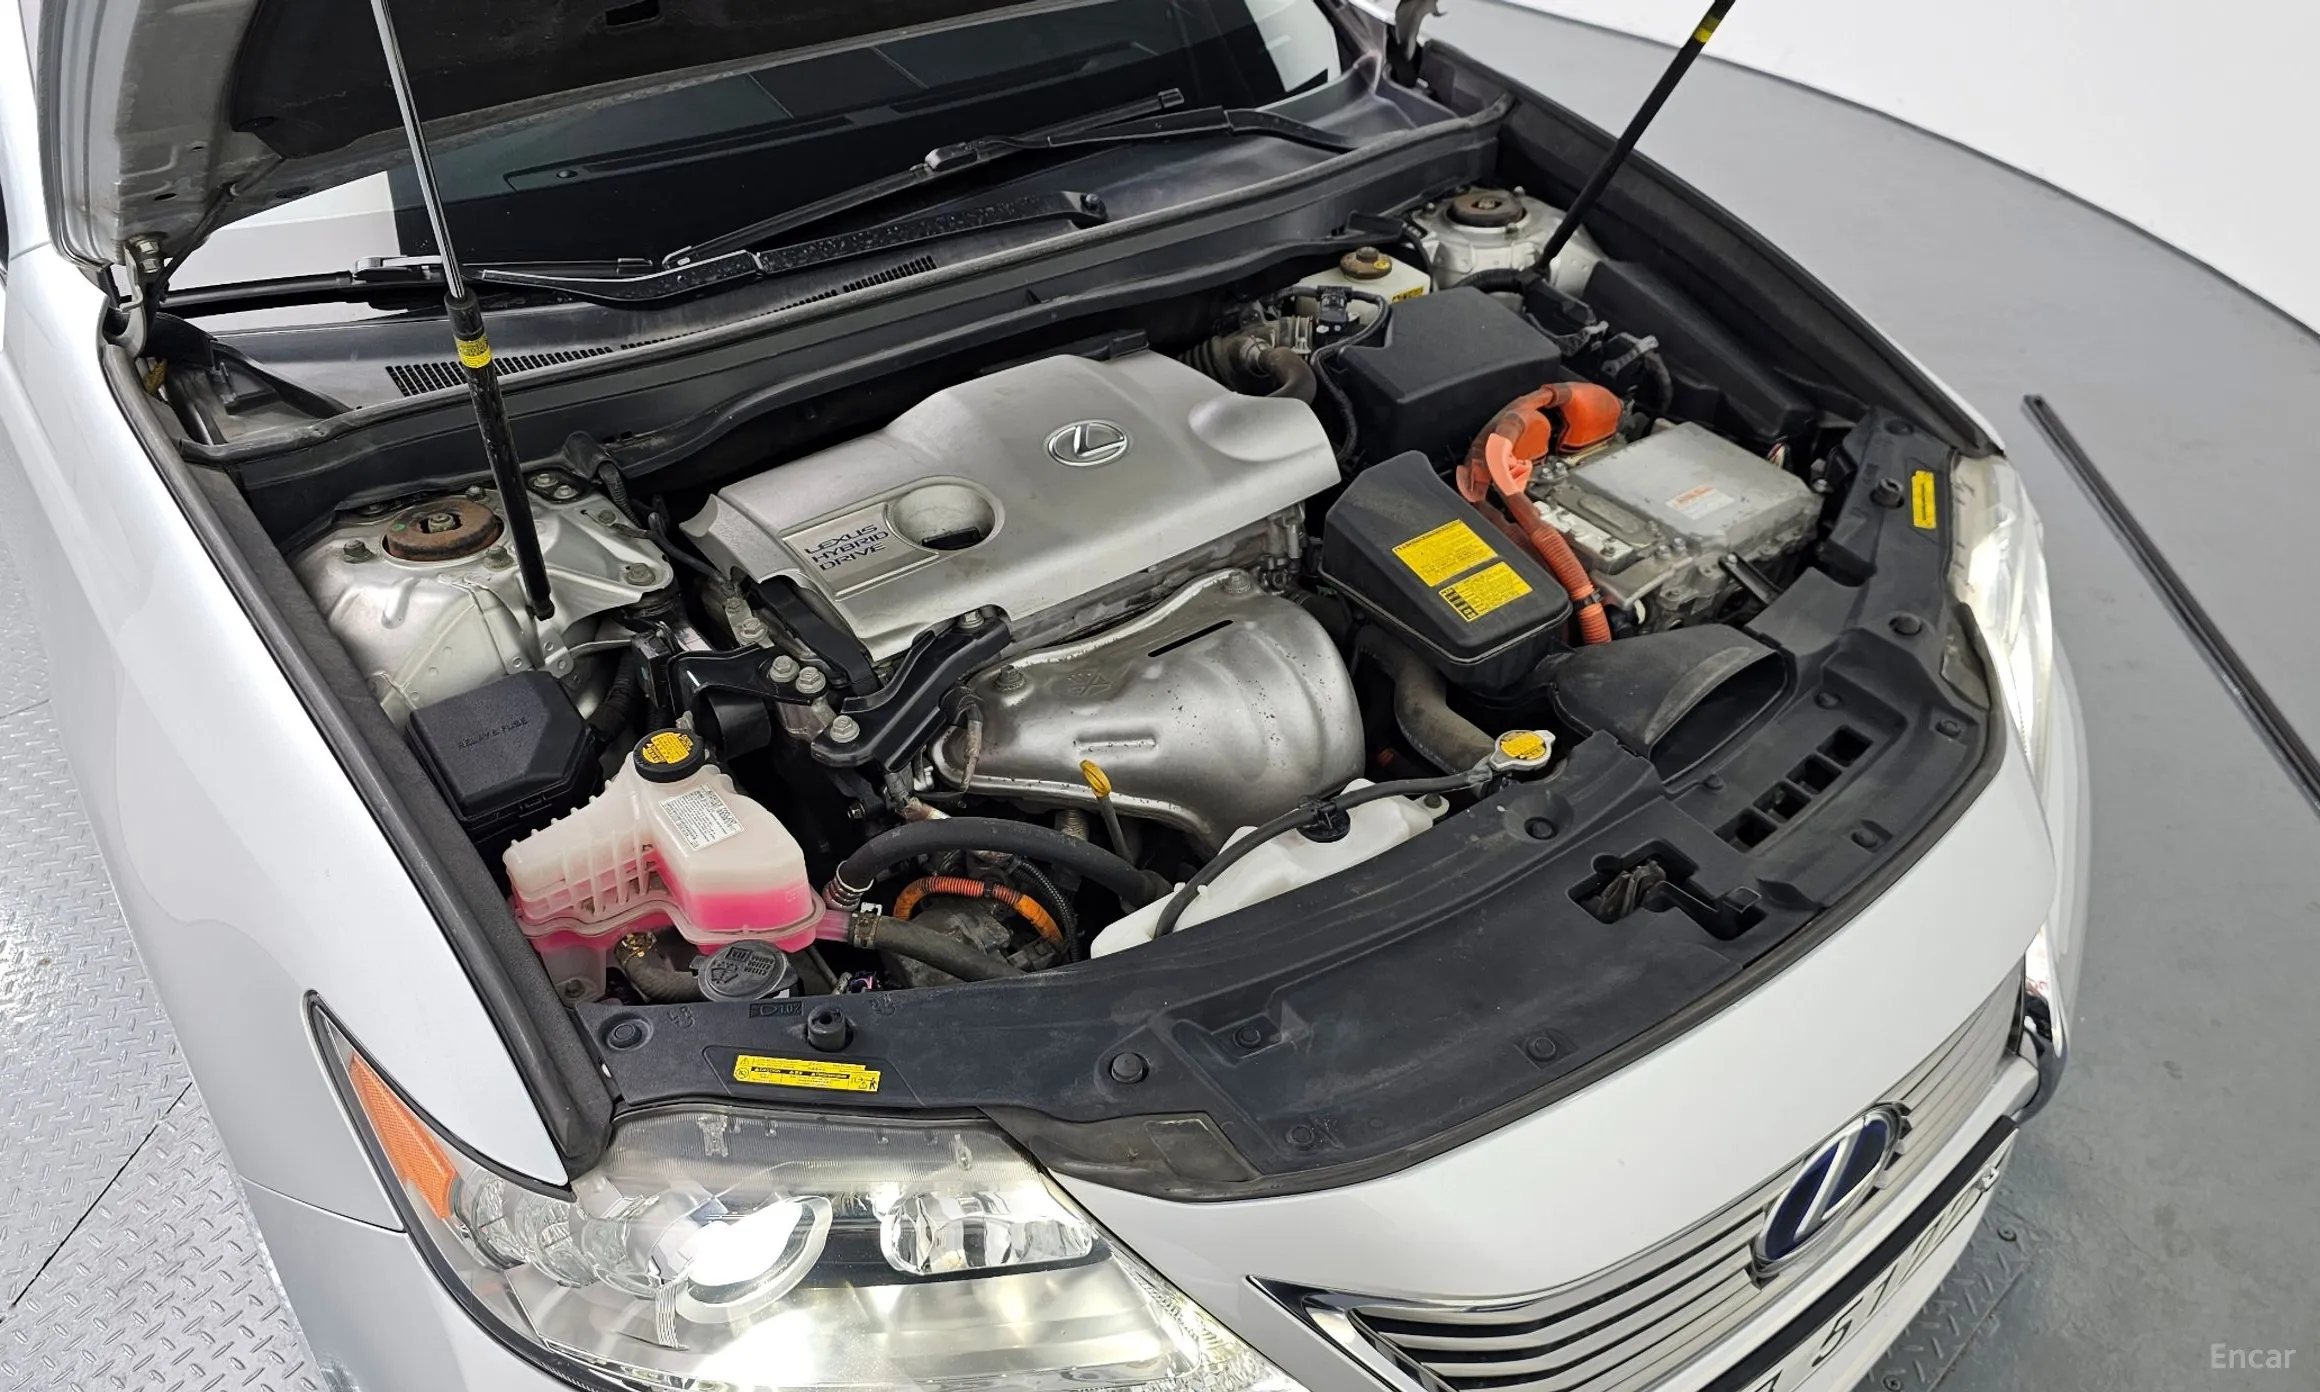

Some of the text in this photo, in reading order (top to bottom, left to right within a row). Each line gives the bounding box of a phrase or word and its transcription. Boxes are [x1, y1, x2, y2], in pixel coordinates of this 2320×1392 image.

[804, 523, 878, 554] LEXUS
[811, 531, 889, 563] HYBRID
[819, 542, 886, 571] DRIVE
